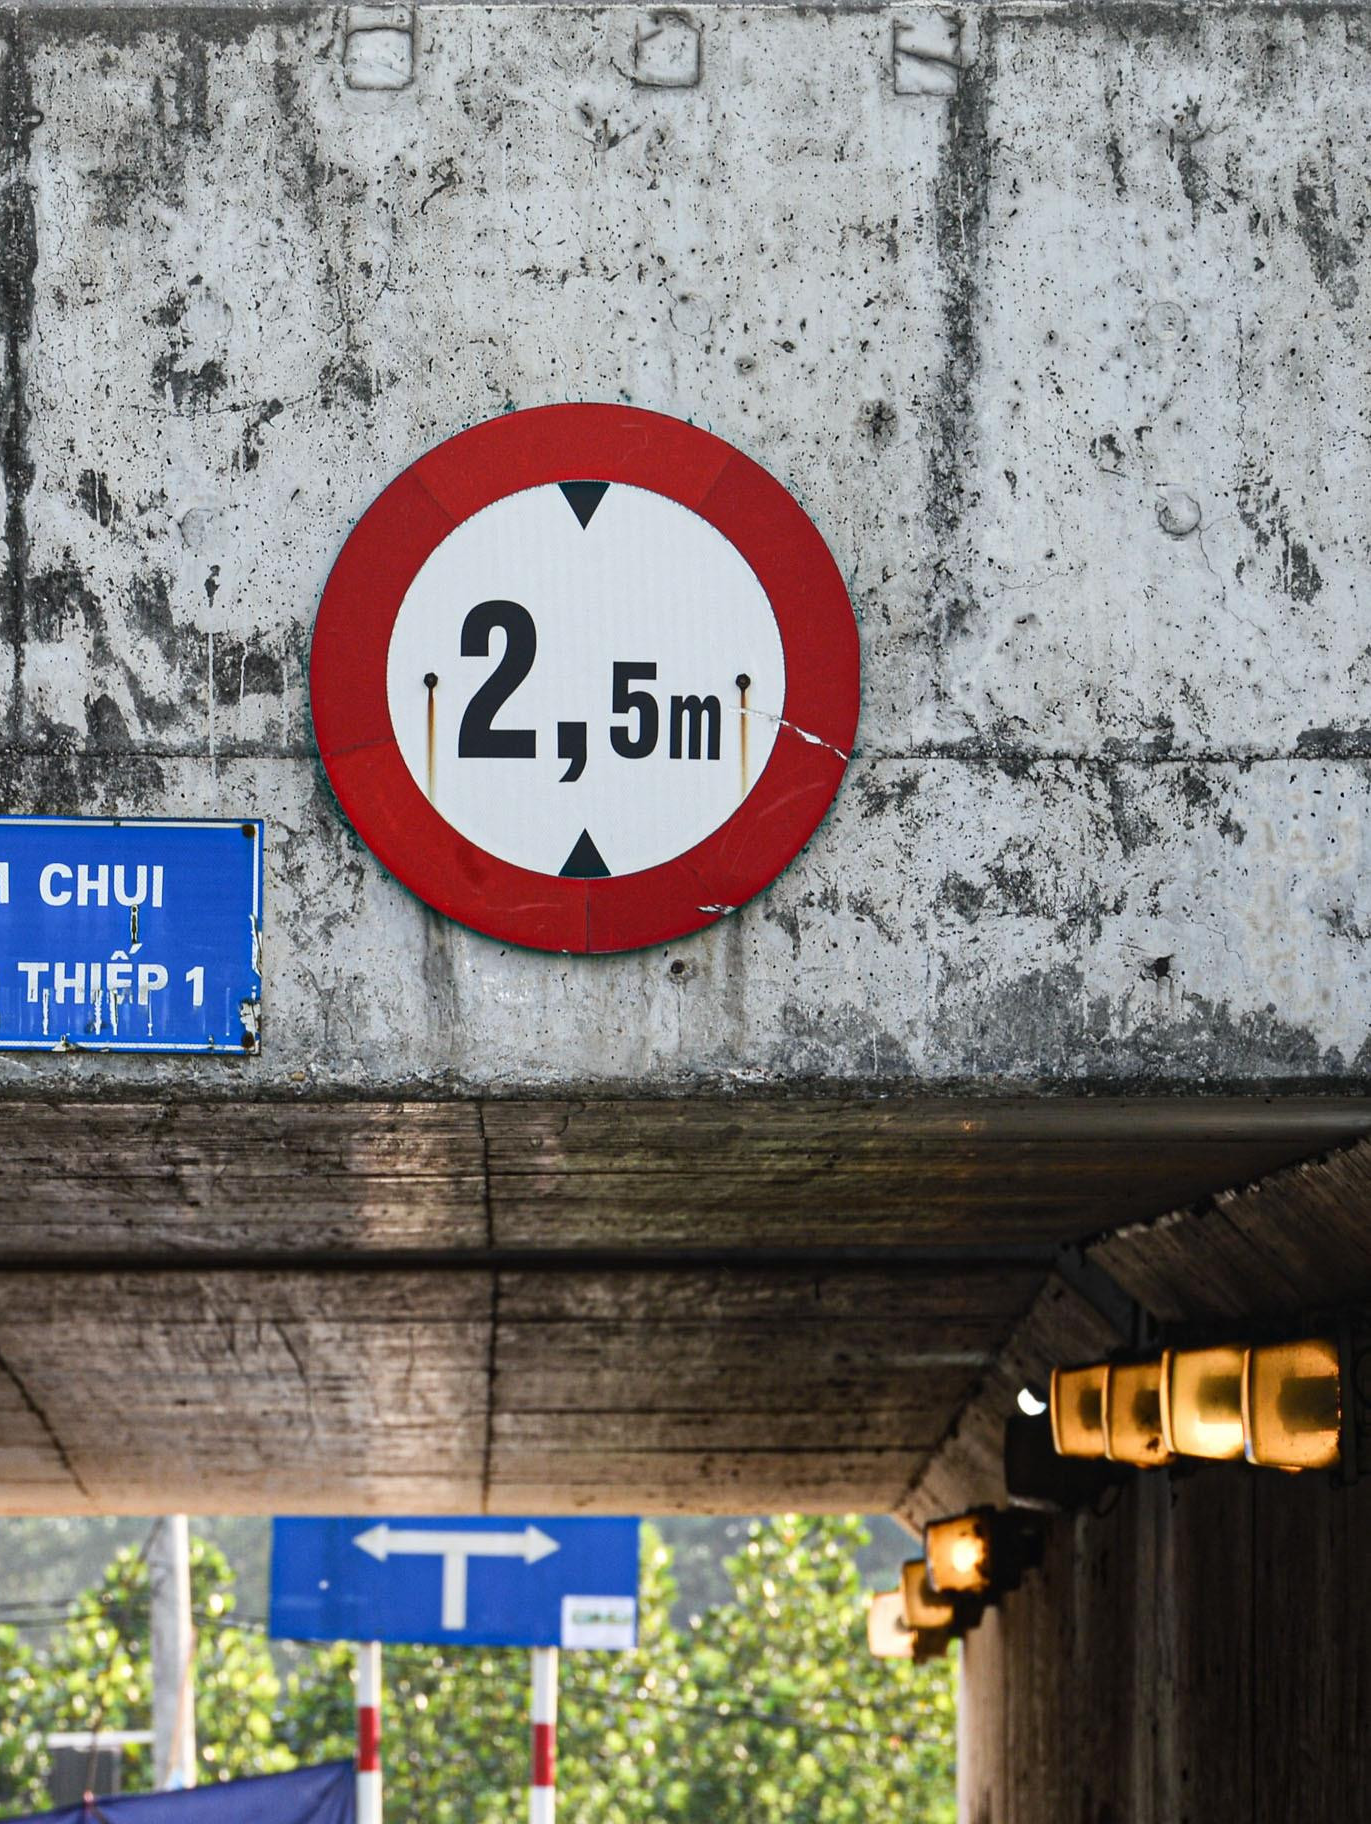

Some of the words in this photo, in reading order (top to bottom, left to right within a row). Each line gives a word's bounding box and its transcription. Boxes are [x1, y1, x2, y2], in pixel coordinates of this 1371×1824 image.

[457, 599, 722, 783] 2,5m
[39, 862, 164, 908] CHUI
[17, 942, 170, 1006] THIẾP
[185, 965, 206, 1007] 1
